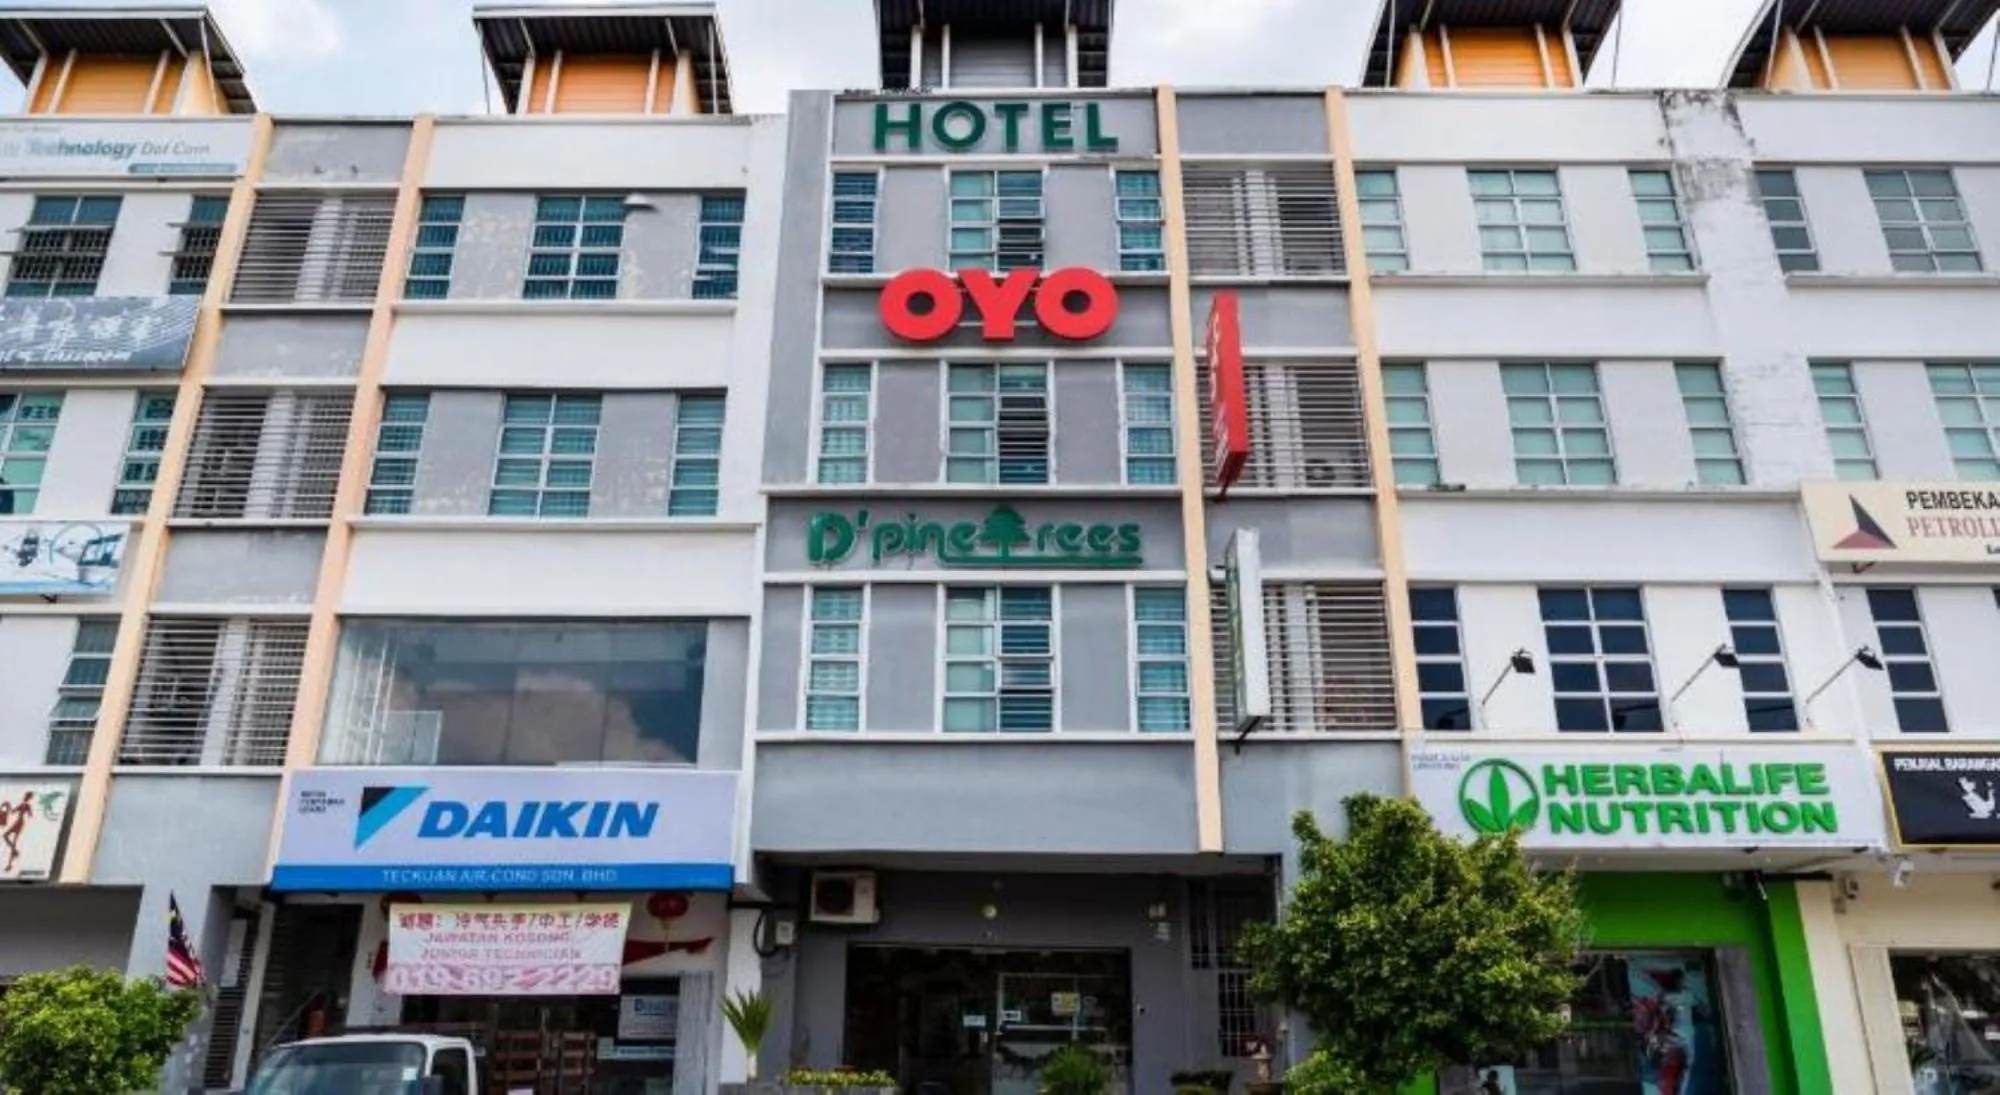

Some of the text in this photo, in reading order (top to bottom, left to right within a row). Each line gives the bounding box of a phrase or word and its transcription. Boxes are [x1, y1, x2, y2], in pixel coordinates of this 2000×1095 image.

[873, 101, 1119, 150] HOTEL
[878, 266, 1119, 342] OYO
[1542, 763, 1830, 796] HERBALIFE
[418, 801, 660, 839] DAIKIN
[1549, 801, 1838, 834] NUTRITION
